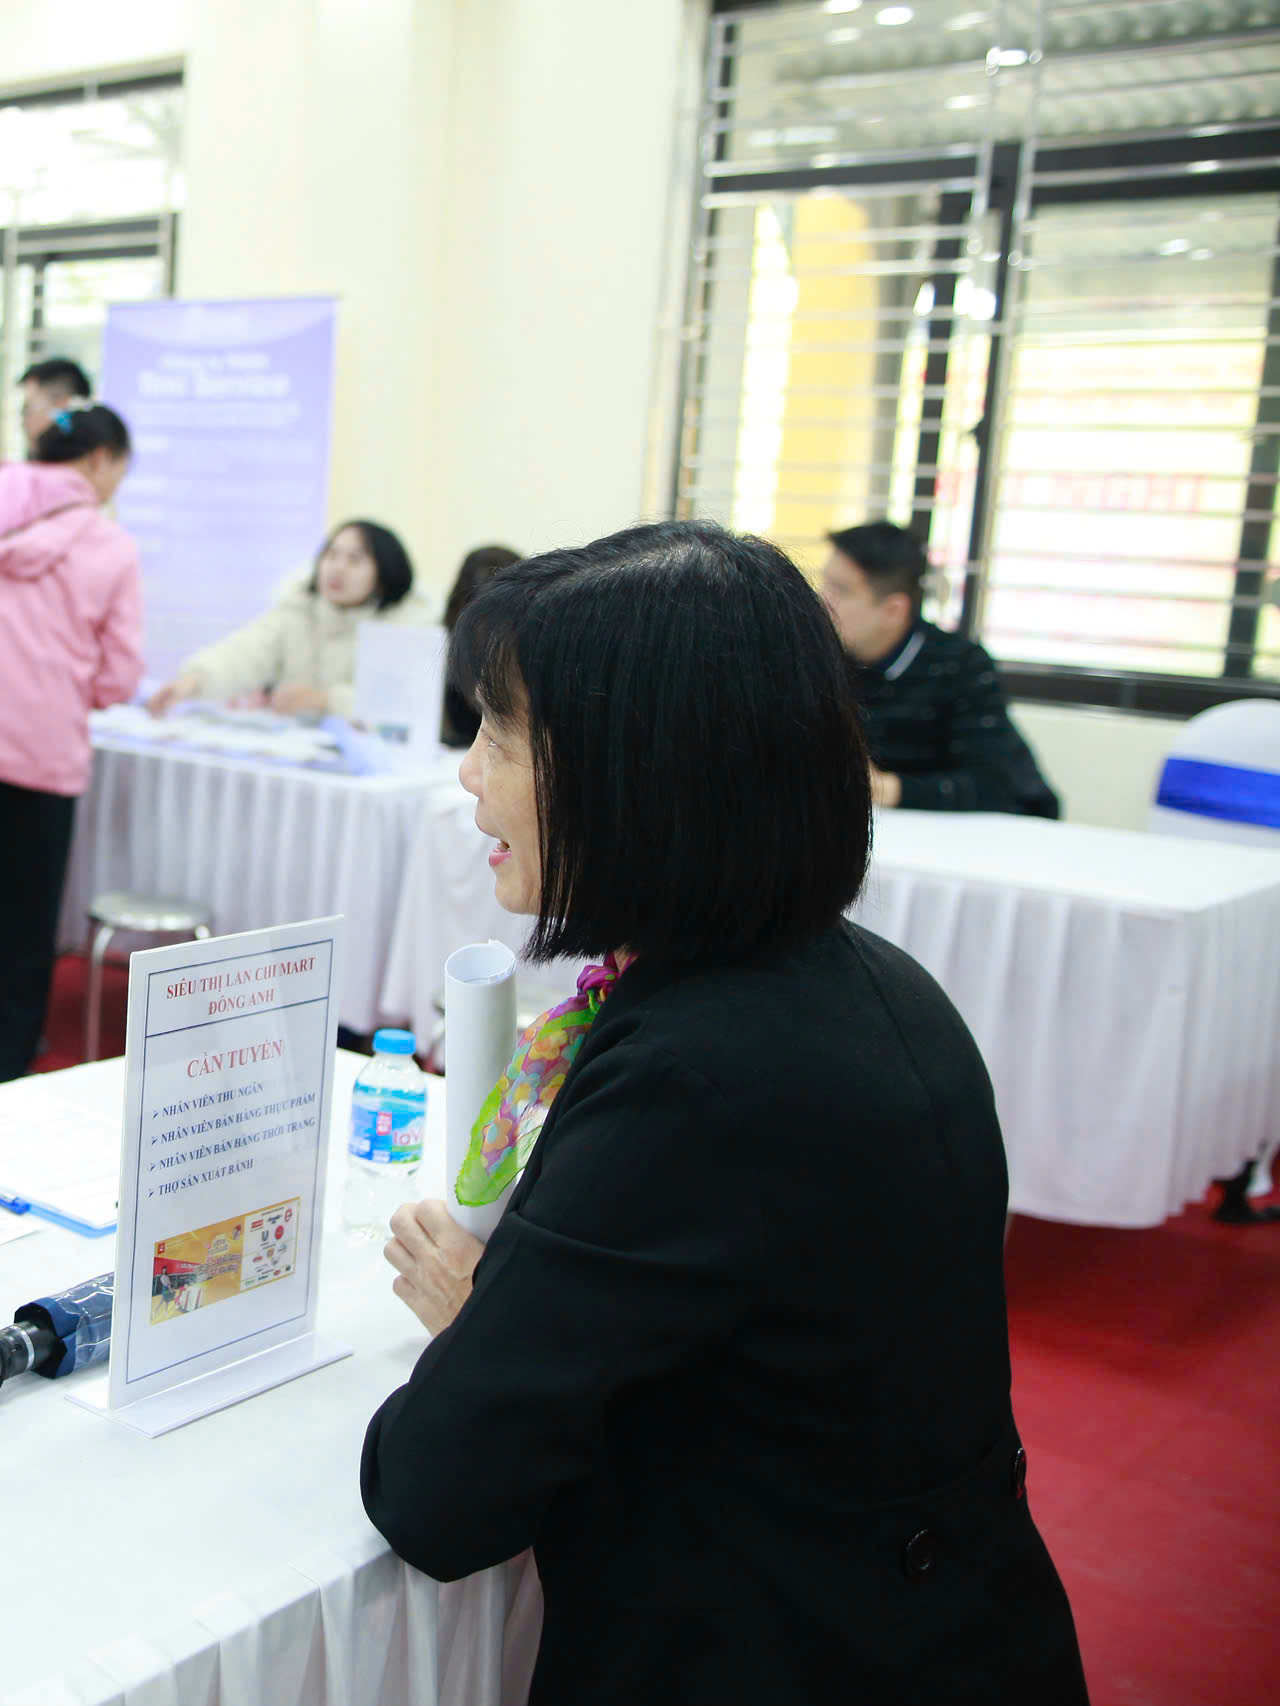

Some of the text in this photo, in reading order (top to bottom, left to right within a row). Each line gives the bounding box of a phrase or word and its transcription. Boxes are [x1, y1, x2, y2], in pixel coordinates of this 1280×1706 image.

[166, 956, 316, 999] SIÊU THỊ LAN CHI MART
[208, 988, 275, 1015] ĐÔNG ANH
[162, 1100, 190, 1117] NHÂN
[192, 1094, 216, 1109] VIÊN
[217, 1090, 236, 1103] THU
[159, 1151, 187, 1170] NHÂN
[189, 1145, 212, 1161] VIÊN
[287, 1117, 316, 1133] TRANG
[160, 1126, 189, 1144] NHÂN
[191, 1119, 214, 1135] VIÊN
